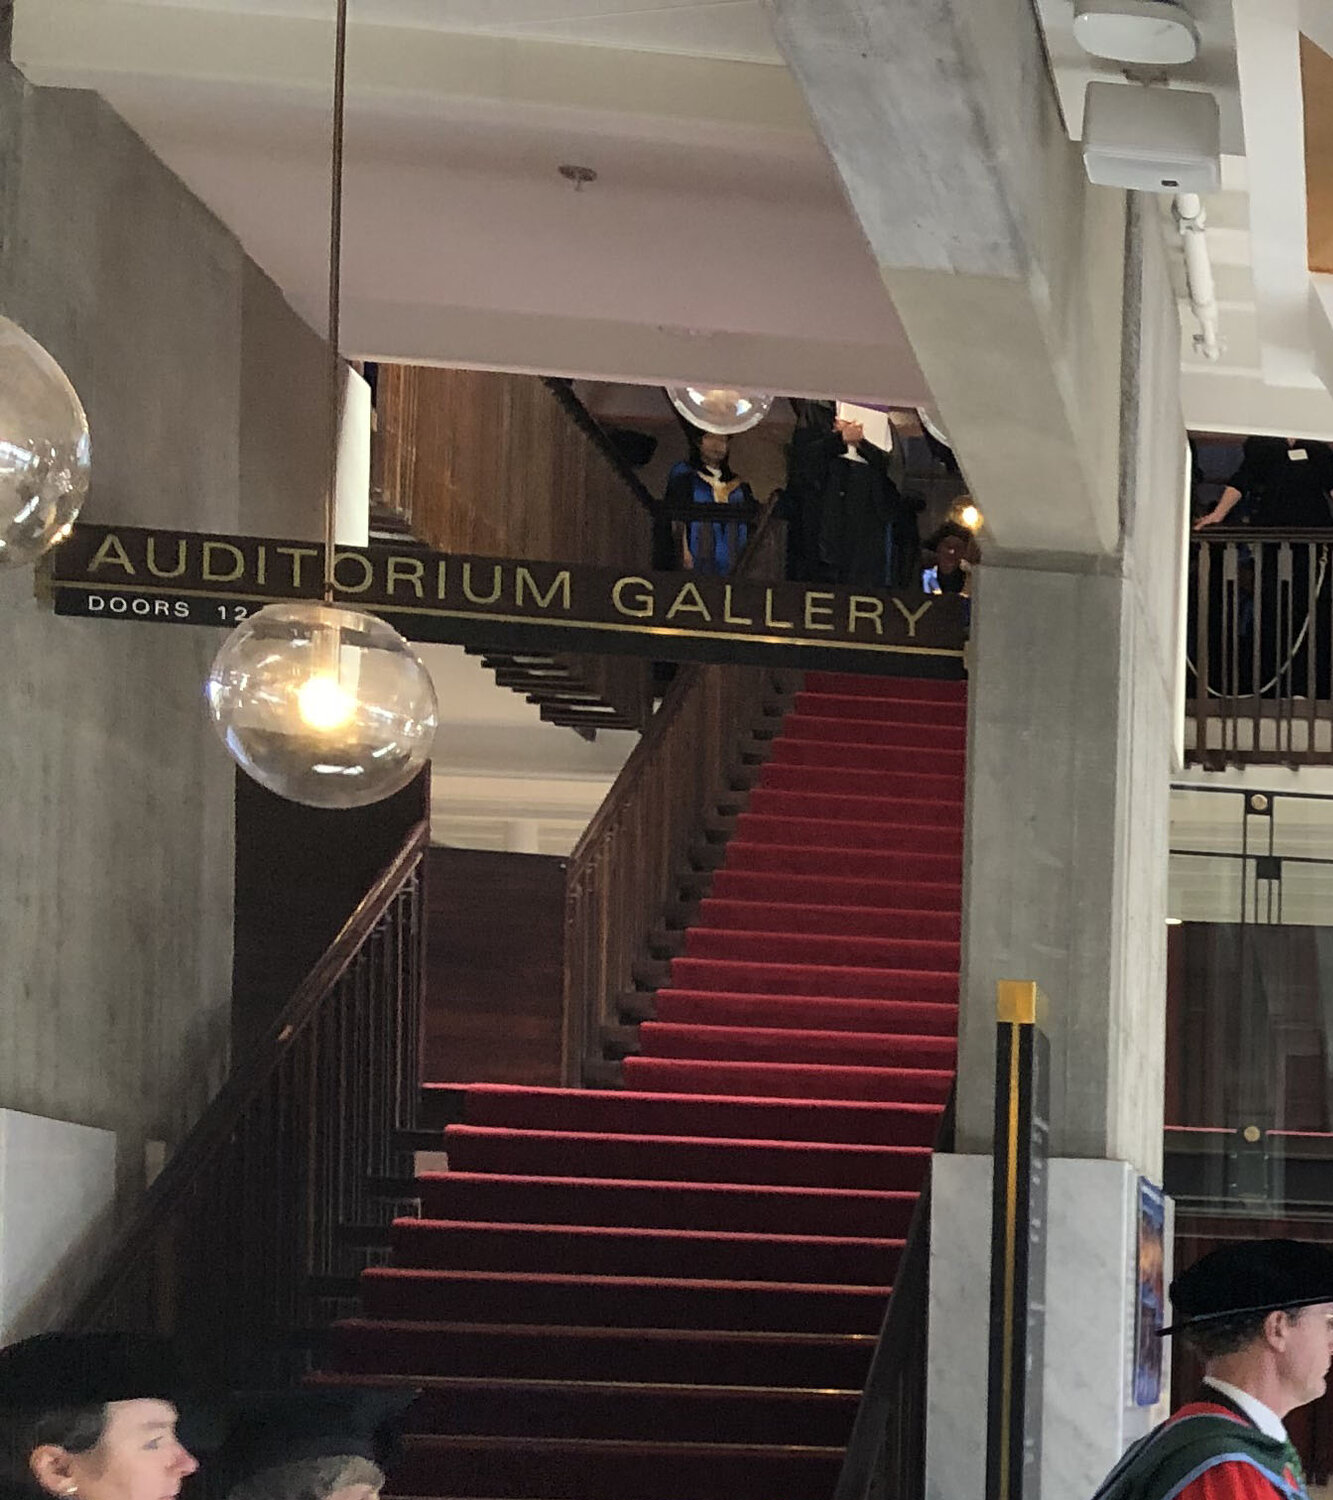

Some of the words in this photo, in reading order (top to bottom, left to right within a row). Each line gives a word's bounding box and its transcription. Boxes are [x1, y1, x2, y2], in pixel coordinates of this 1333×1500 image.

[86, 533, 572, 609] AUDITORIUM
[612, 576, 933, 637] GALLERY
[87, 595, 190, 617] DOORS
